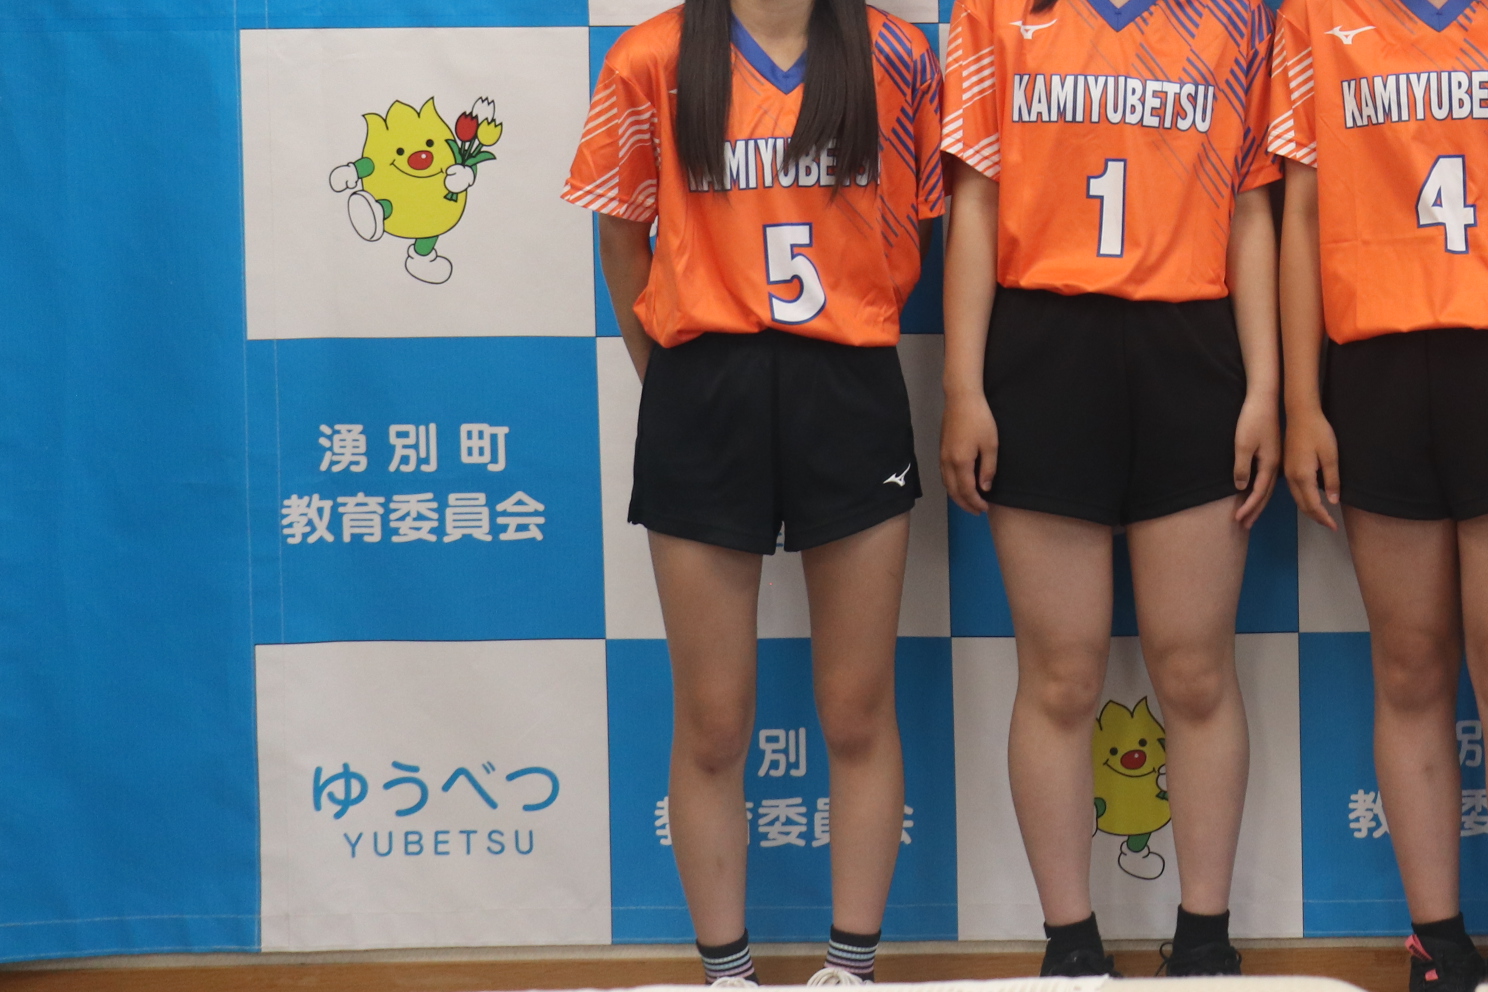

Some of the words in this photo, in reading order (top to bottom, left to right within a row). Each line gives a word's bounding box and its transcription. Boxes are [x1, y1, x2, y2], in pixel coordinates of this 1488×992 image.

[1010, 72, 1216, 135] KAMIYUBETSU
[1087, 158, 1127, 259] 1
[1417, 154, 1478, 255] 4
[762, 221, 827, 326] 5
[318, 422, 510, 473] 湧別町
[280, 490, 546, 545] 教育委員会
[312, 761, 560, 820] ゆうべつ
[344, 829, 534, 857] YUBETSU
